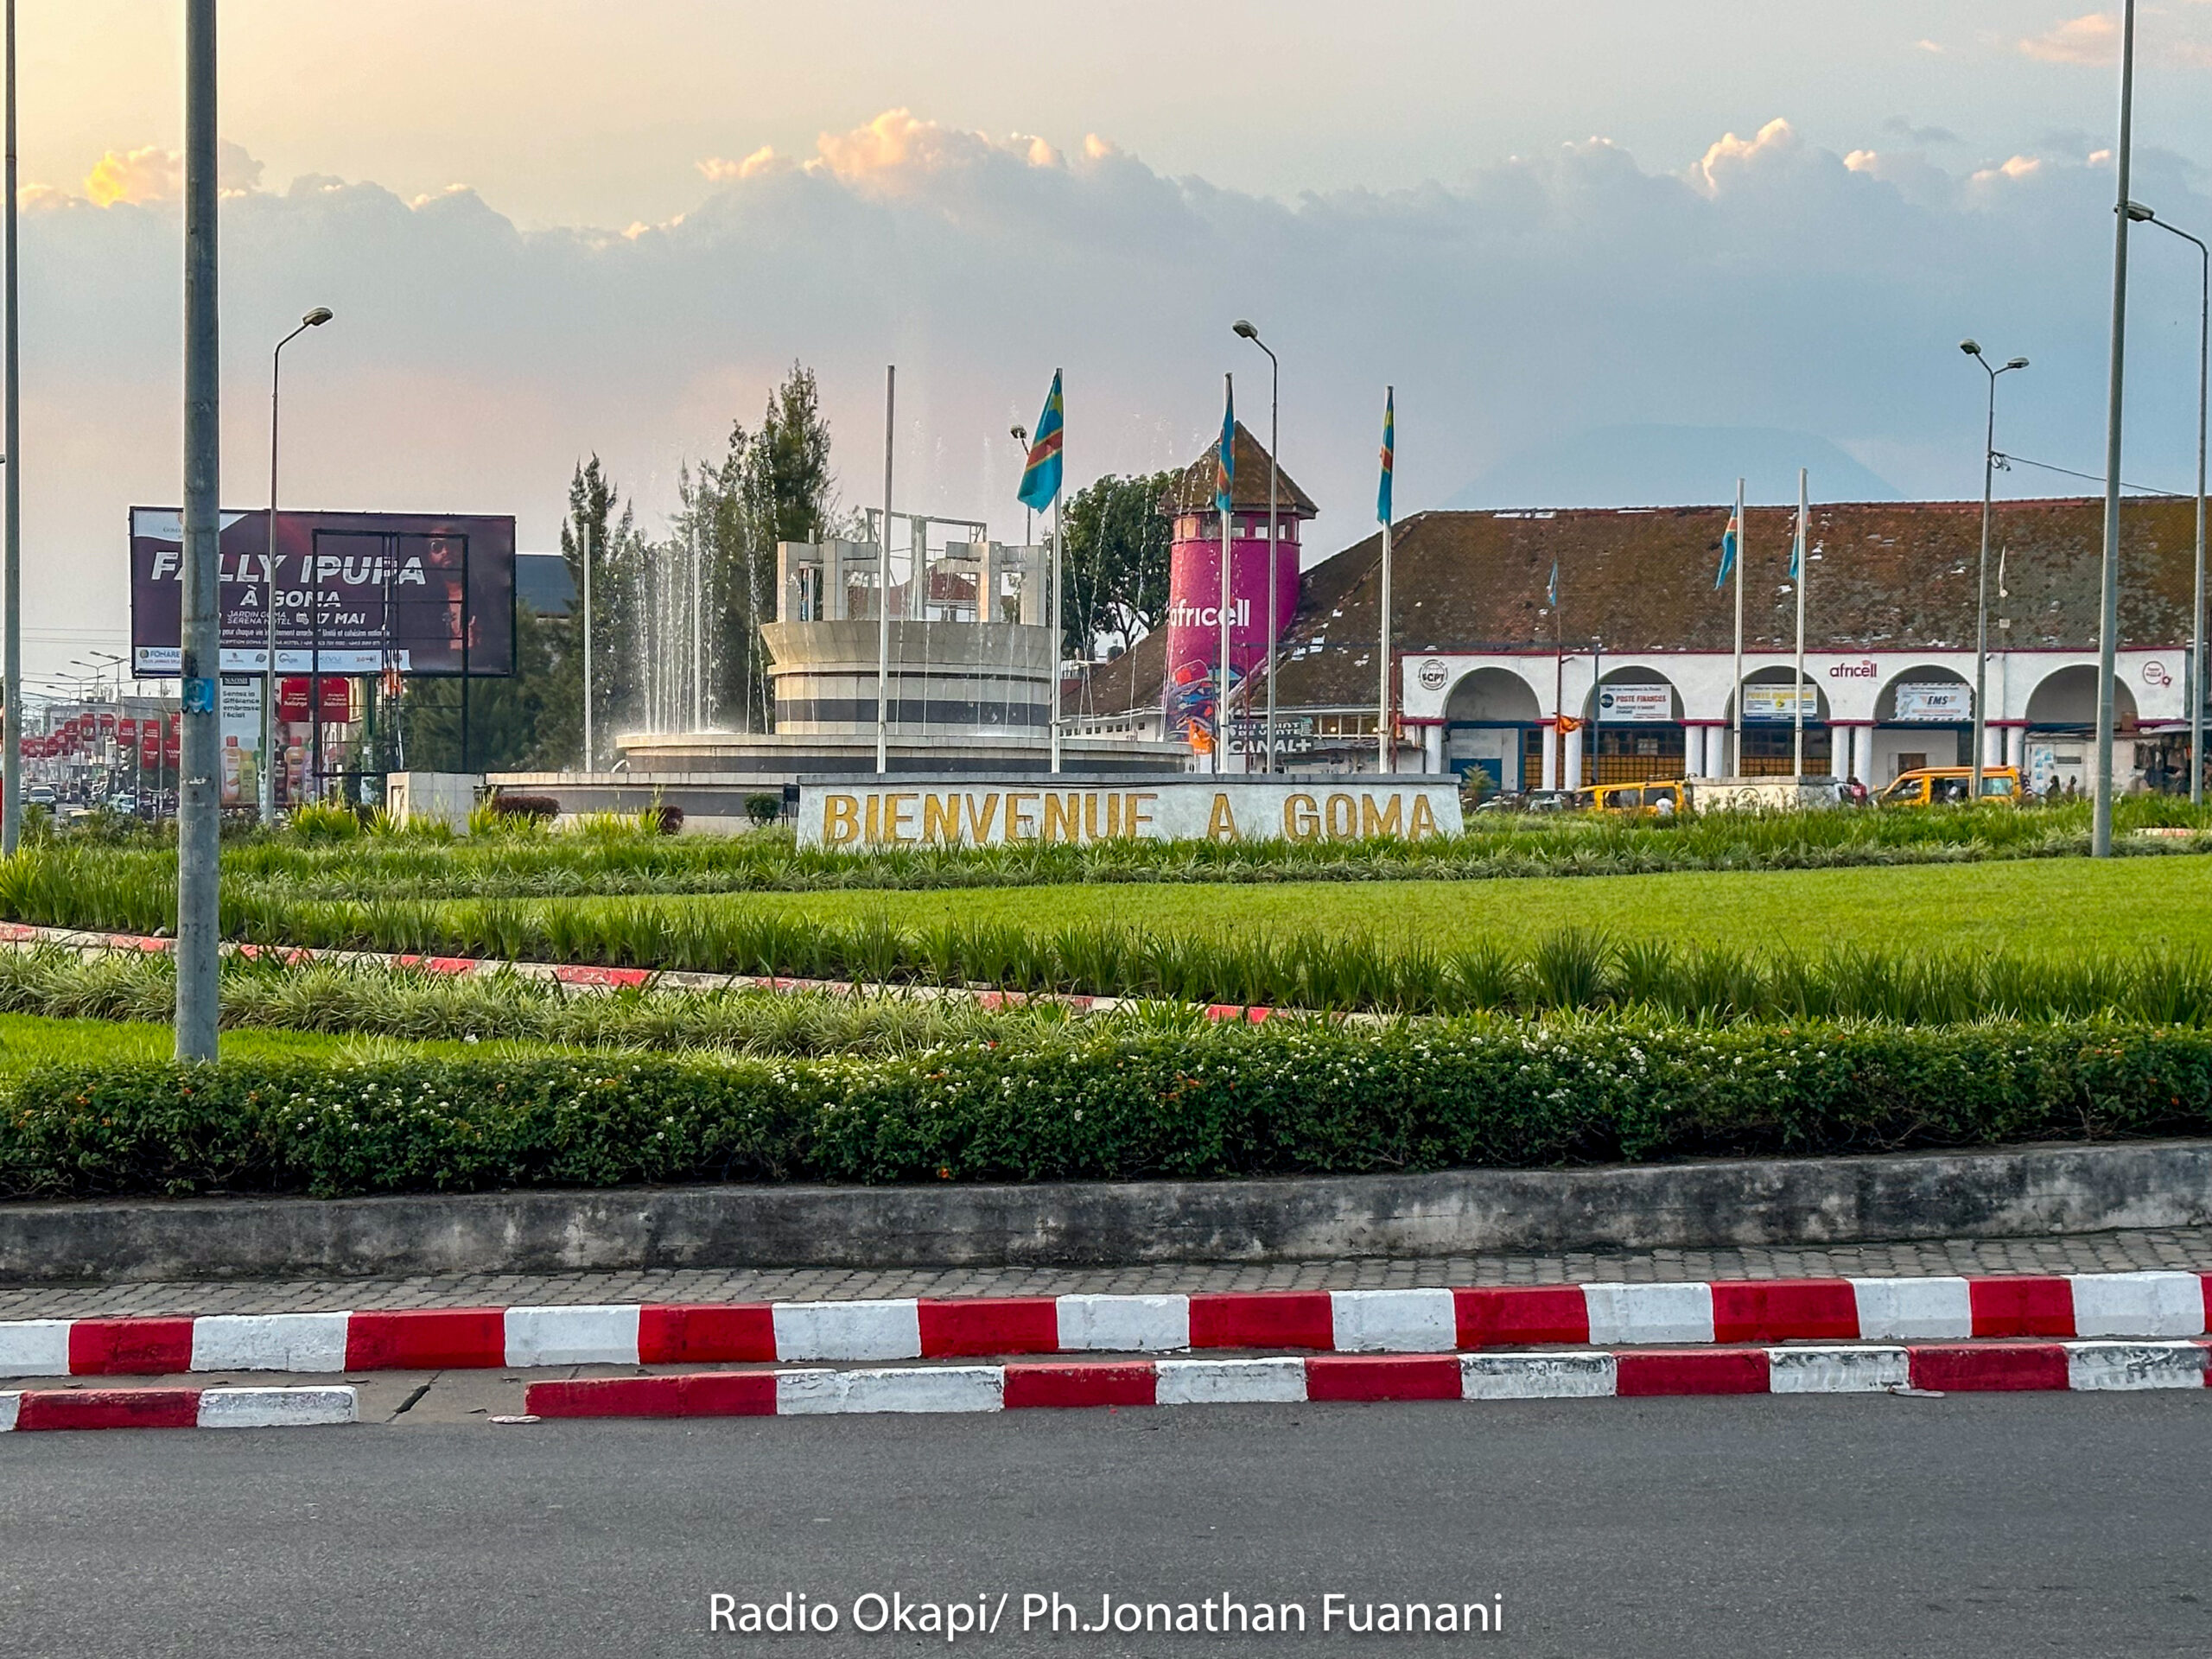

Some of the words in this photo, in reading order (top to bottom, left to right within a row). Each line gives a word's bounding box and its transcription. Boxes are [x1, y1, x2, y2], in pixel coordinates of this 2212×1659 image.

[151, 551, 287, 582] FLLY
[240, 584, 258, 606] À
[334, 613, 365, 624] MAI
[1169, 598, 1250, 626] africell
[1829, 662, 1877, 677] africell
[1927, 696, 1949, 705] EMS
[1228, 738, 1312, 754] CANAL+
[823, 792, 1158, 843] BIENVENUE
[1208, 793, 1238, 842] A
[1284, 793, 1438, 843] GOMA
